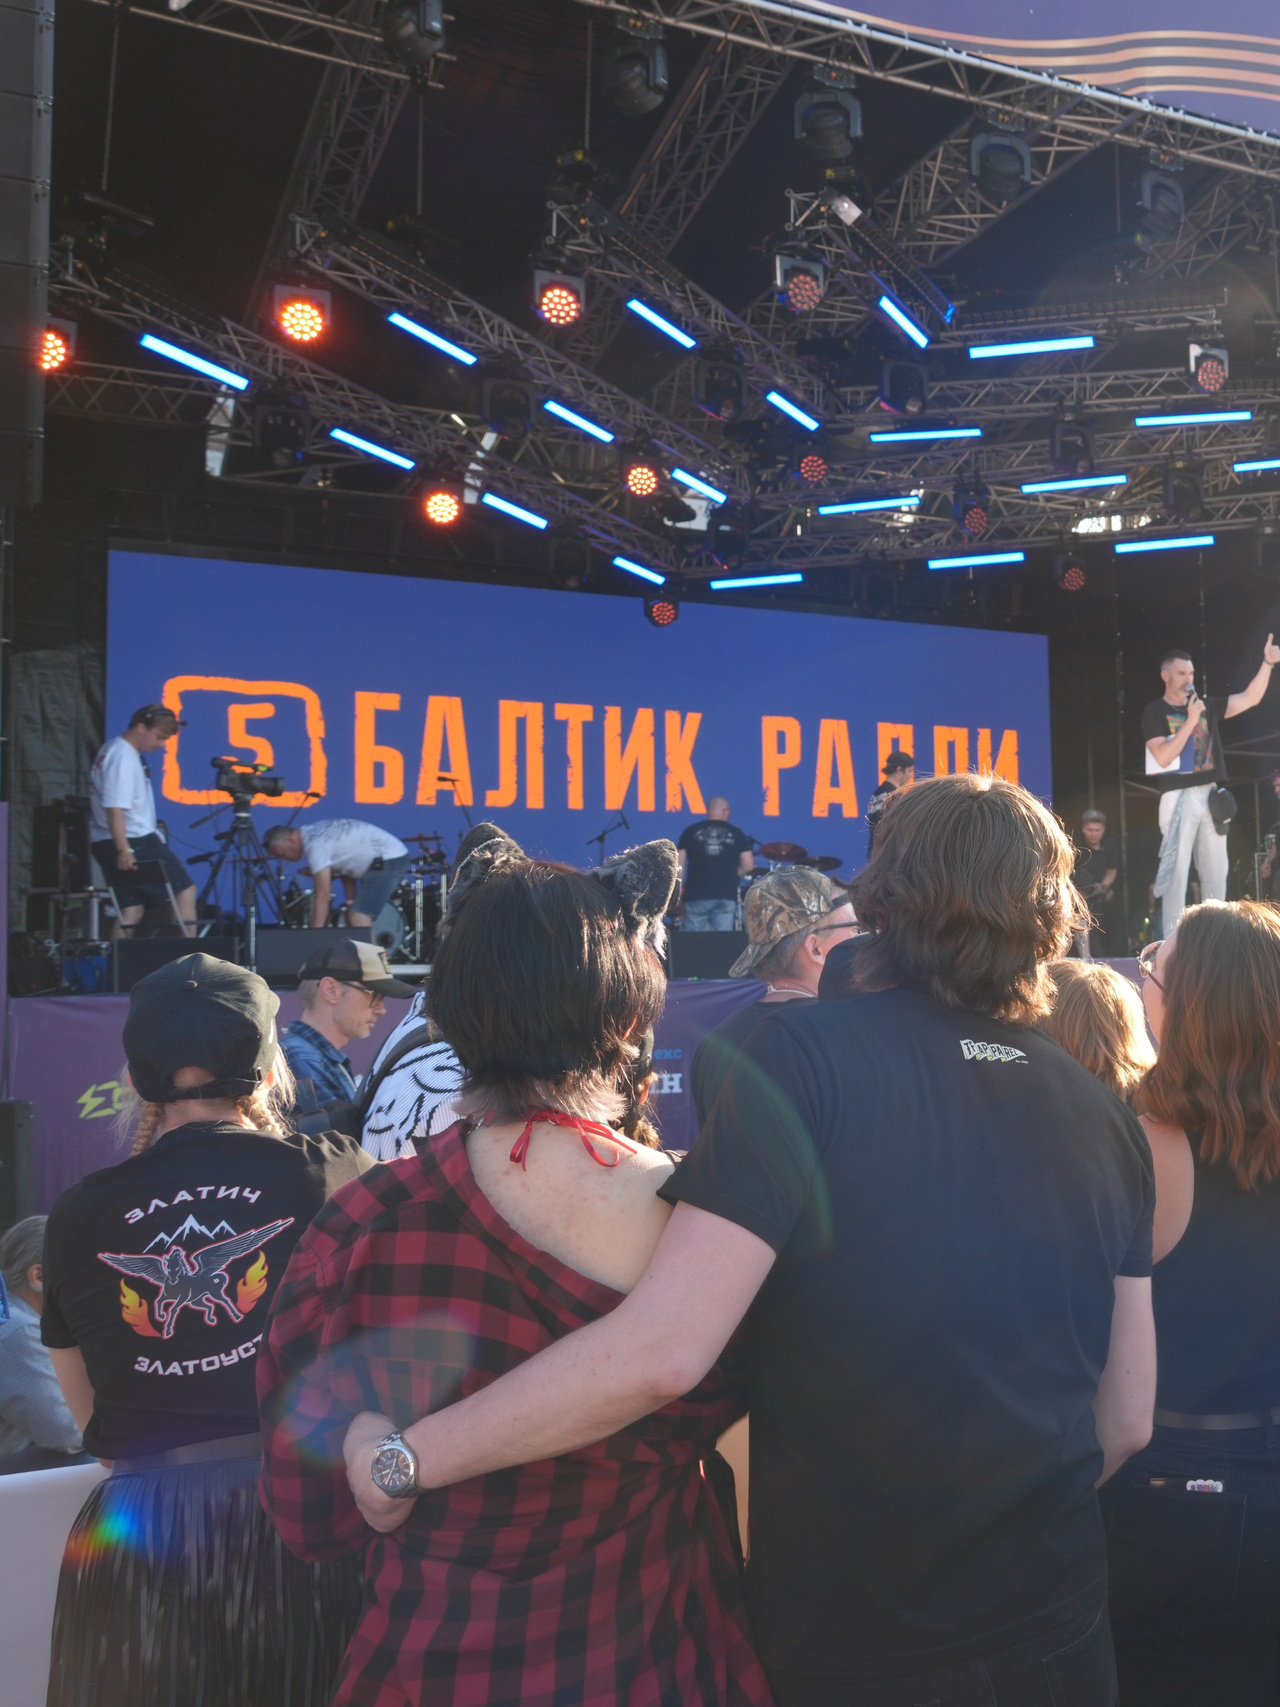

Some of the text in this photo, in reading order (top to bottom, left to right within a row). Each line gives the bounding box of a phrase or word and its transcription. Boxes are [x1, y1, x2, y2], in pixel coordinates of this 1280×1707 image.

[227, 702, 276, 777] 5
[354, 691, 708, 815] БАЛТИК
[124, 1185, 262, 1225] ЗЛАТИЧ
